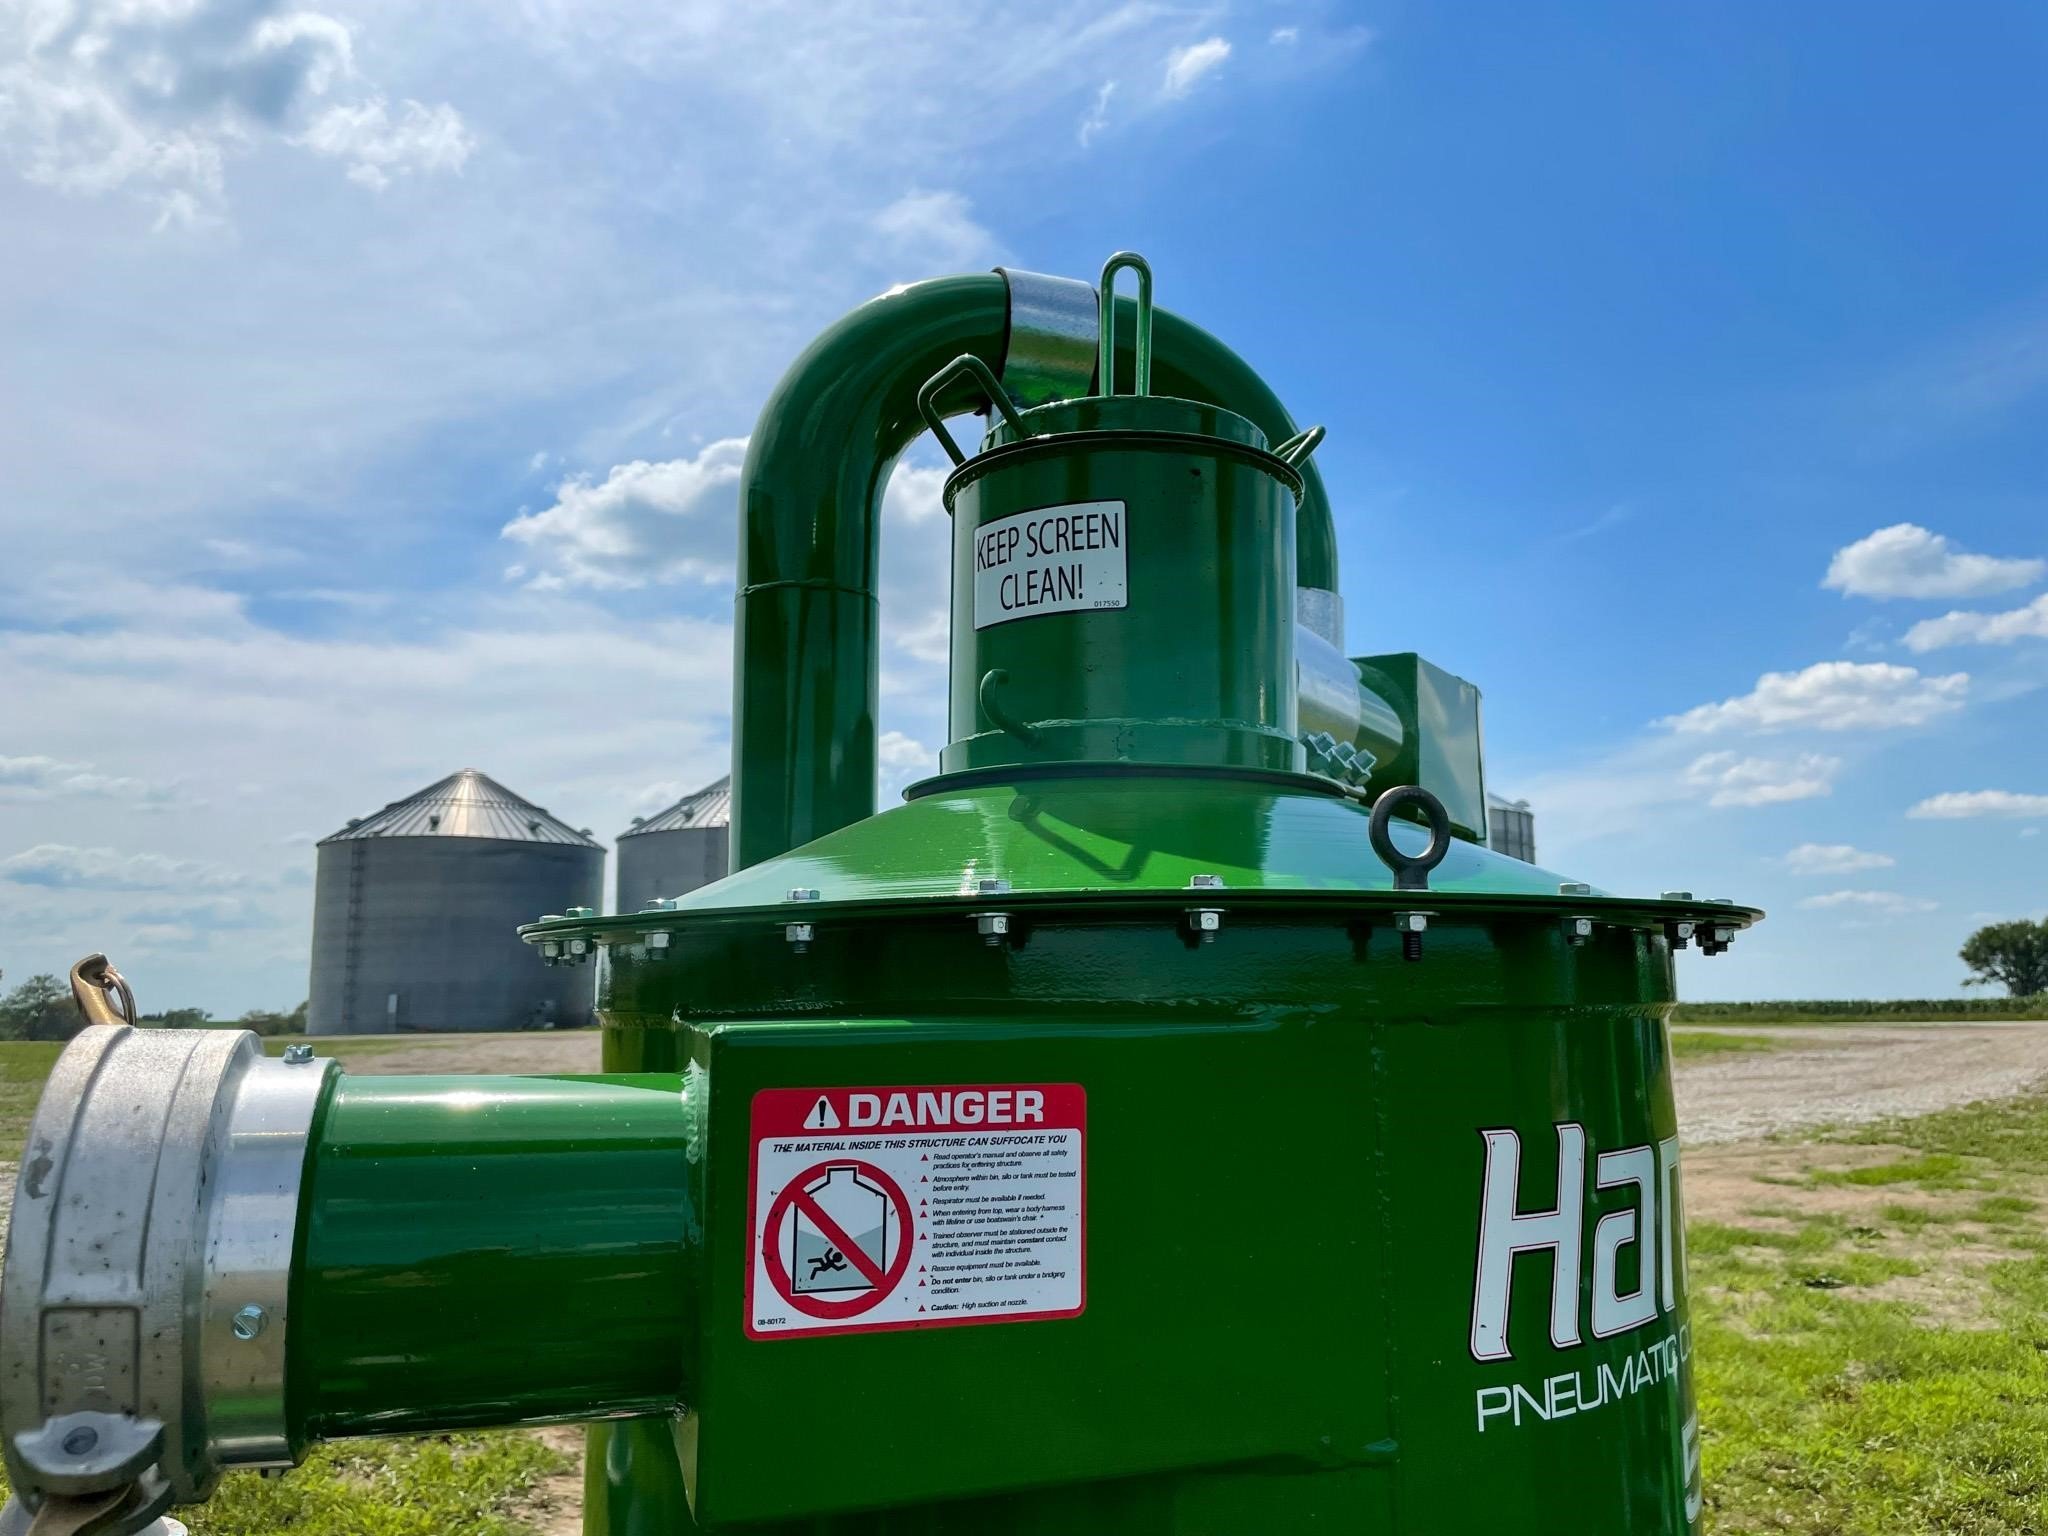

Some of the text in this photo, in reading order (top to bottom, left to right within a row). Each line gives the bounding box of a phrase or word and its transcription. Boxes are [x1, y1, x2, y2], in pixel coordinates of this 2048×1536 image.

[977, 512, 1119, 572] KEEP SCREEN
[1000, 564, 1083, 610] CLEAN!
[848, 1090, 1044, 1127] DANGER
[773, 1135, 1067, 1152] THE MATERIAL INSIDE THIS STRUCTURE CAN SUFFOCATE YOU
[933, 1175, 969, 1183] Atmosphere
[945, 1249, 974, 1257] individual
[956, 1262, 988, 1272] equipment
[1042, 1271, 1065, 1279] bridging
[1476, 1334, 1678, 1432] PNEUMATIC
